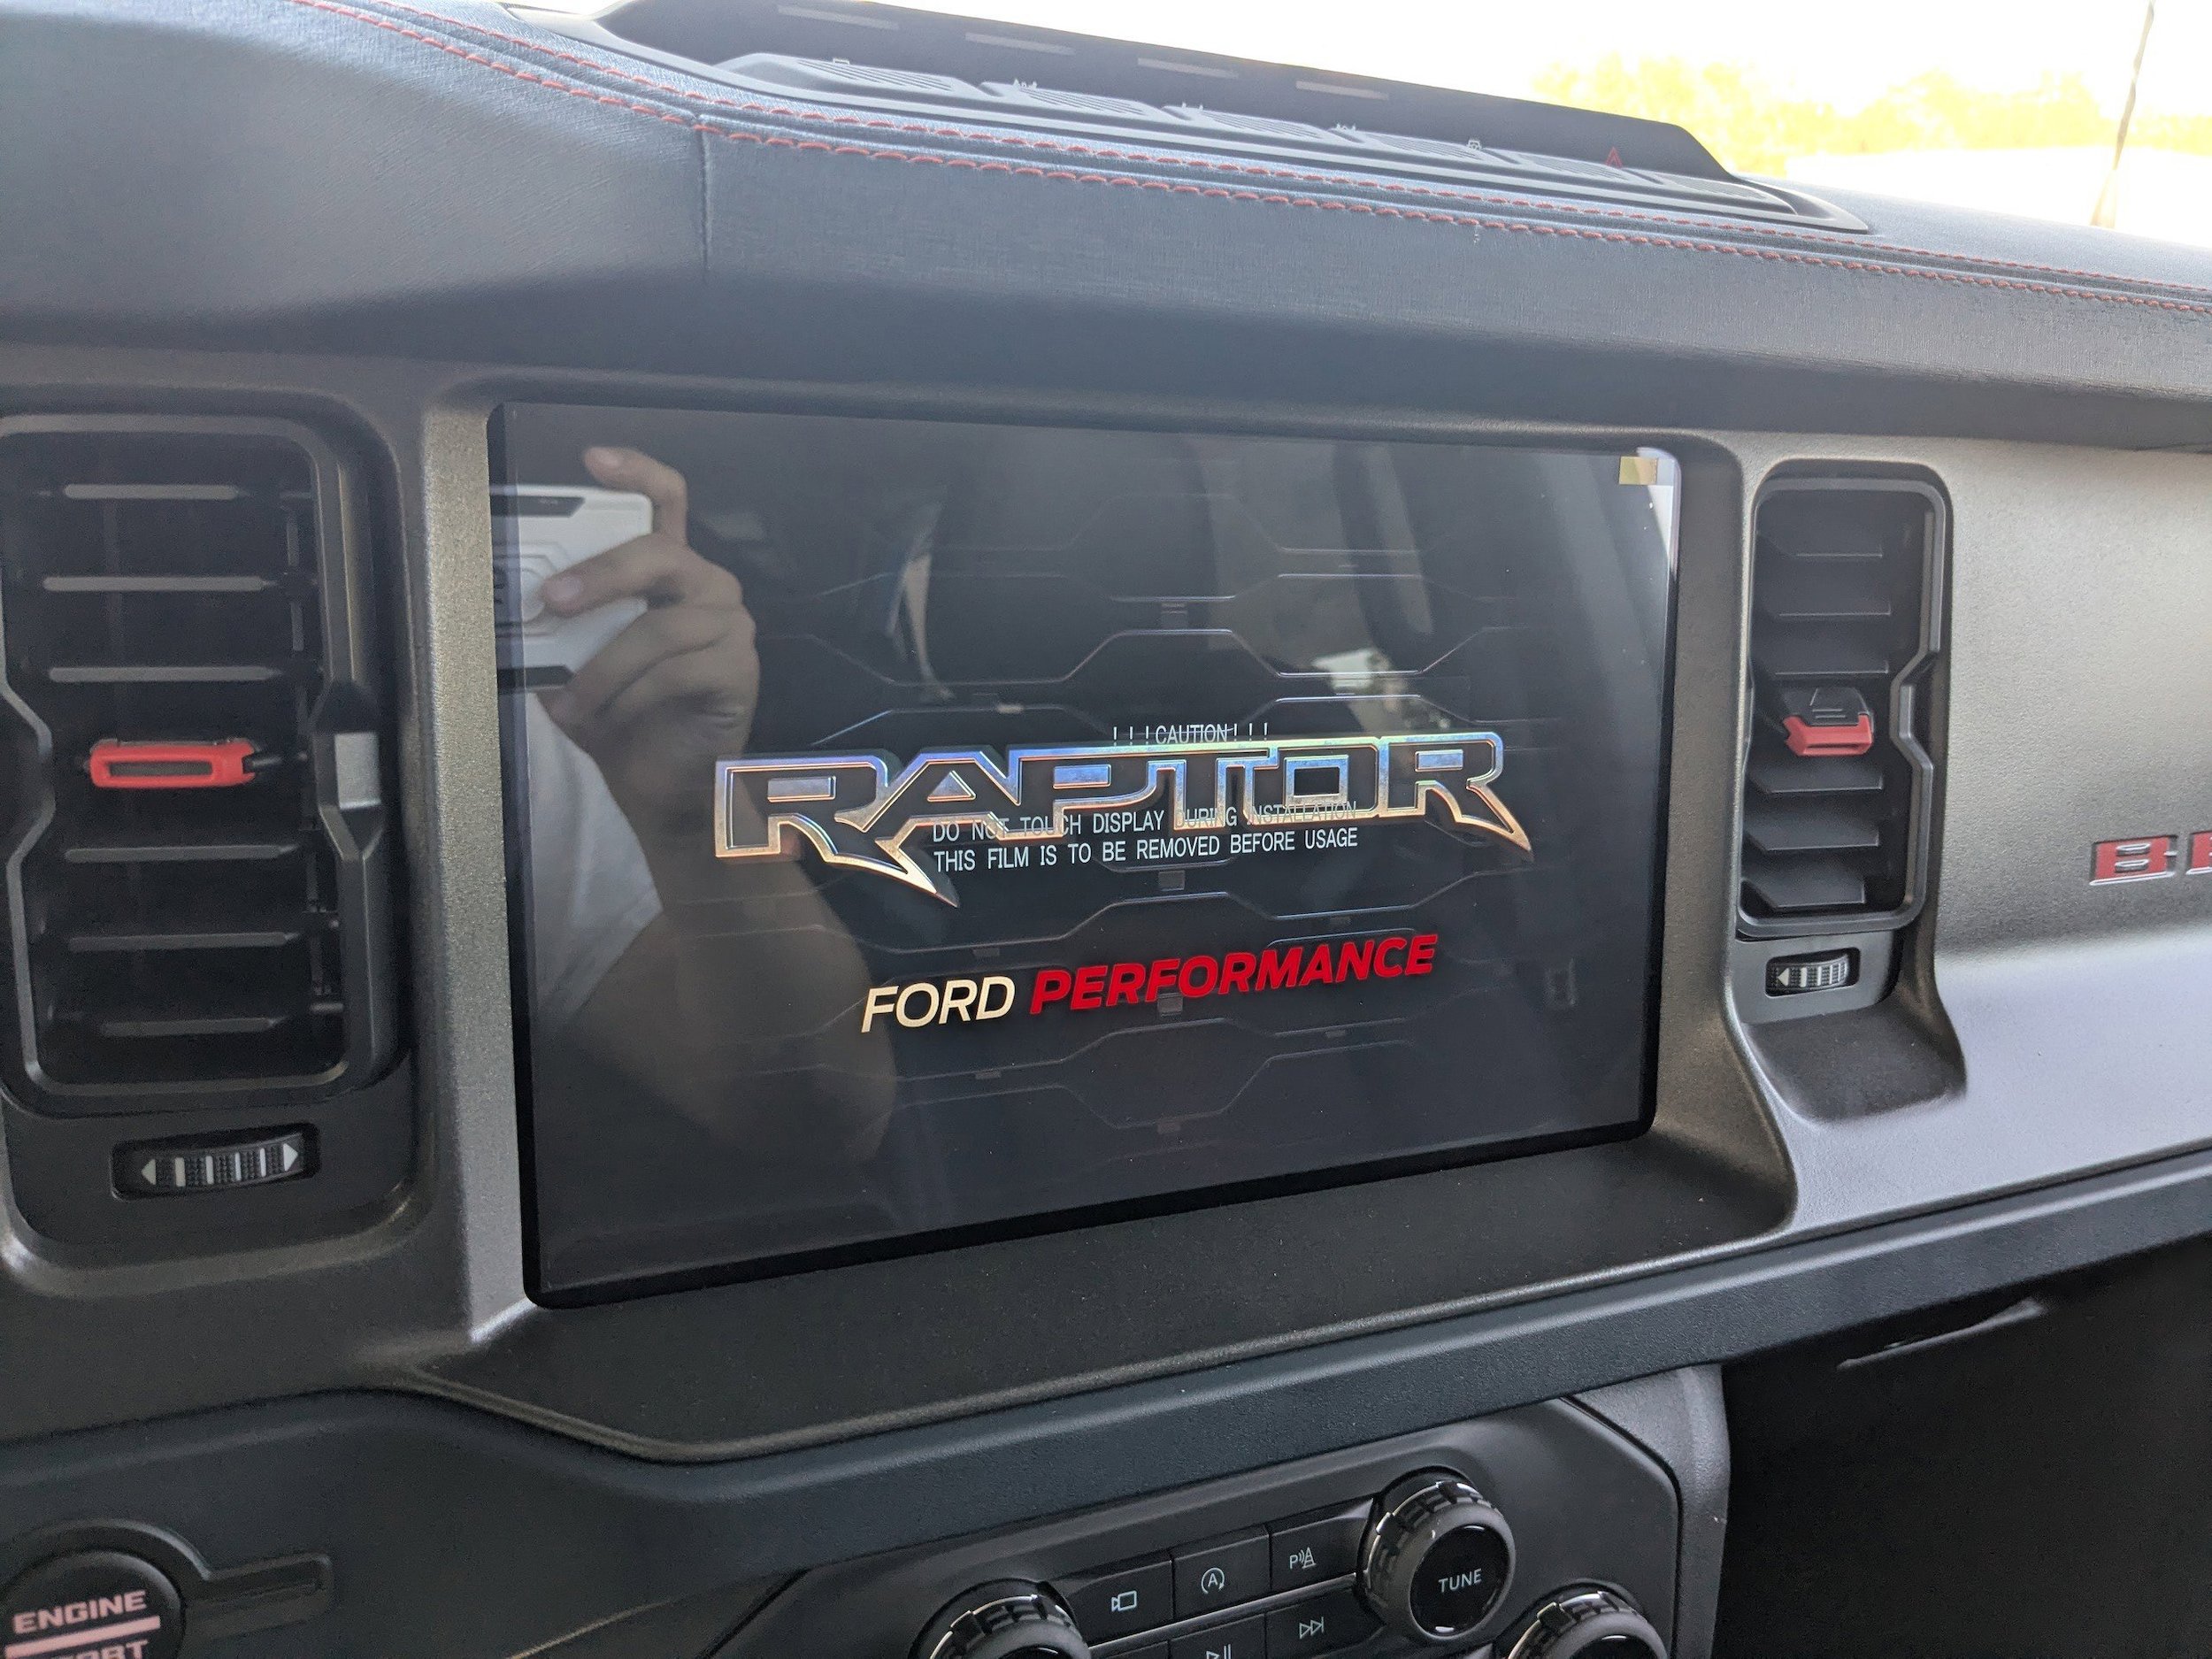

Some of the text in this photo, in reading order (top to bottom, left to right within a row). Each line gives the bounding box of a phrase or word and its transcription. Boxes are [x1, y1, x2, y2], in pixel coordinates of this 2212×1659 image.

[714, 732, 1532, 906] RAPTOR
[933, 821, 959, 842] DO
[972, 818, 1010, 841] NOT
[1019, 813, 1081, 837] TOUCH
[1093, 810, 1165, 834] DISPLAY
[1175, 805, 1238, 830] DURING
[933, 826, 1358, 872] THIS FILM IS TO BE REMOVED BEFORE USAGE
[861, 933, 1439, 1033] FORD PERFORMANCE
[1438, 1568, 1483, 1593] TUNE
[13, 1590, 147, 1634] ENGINE
